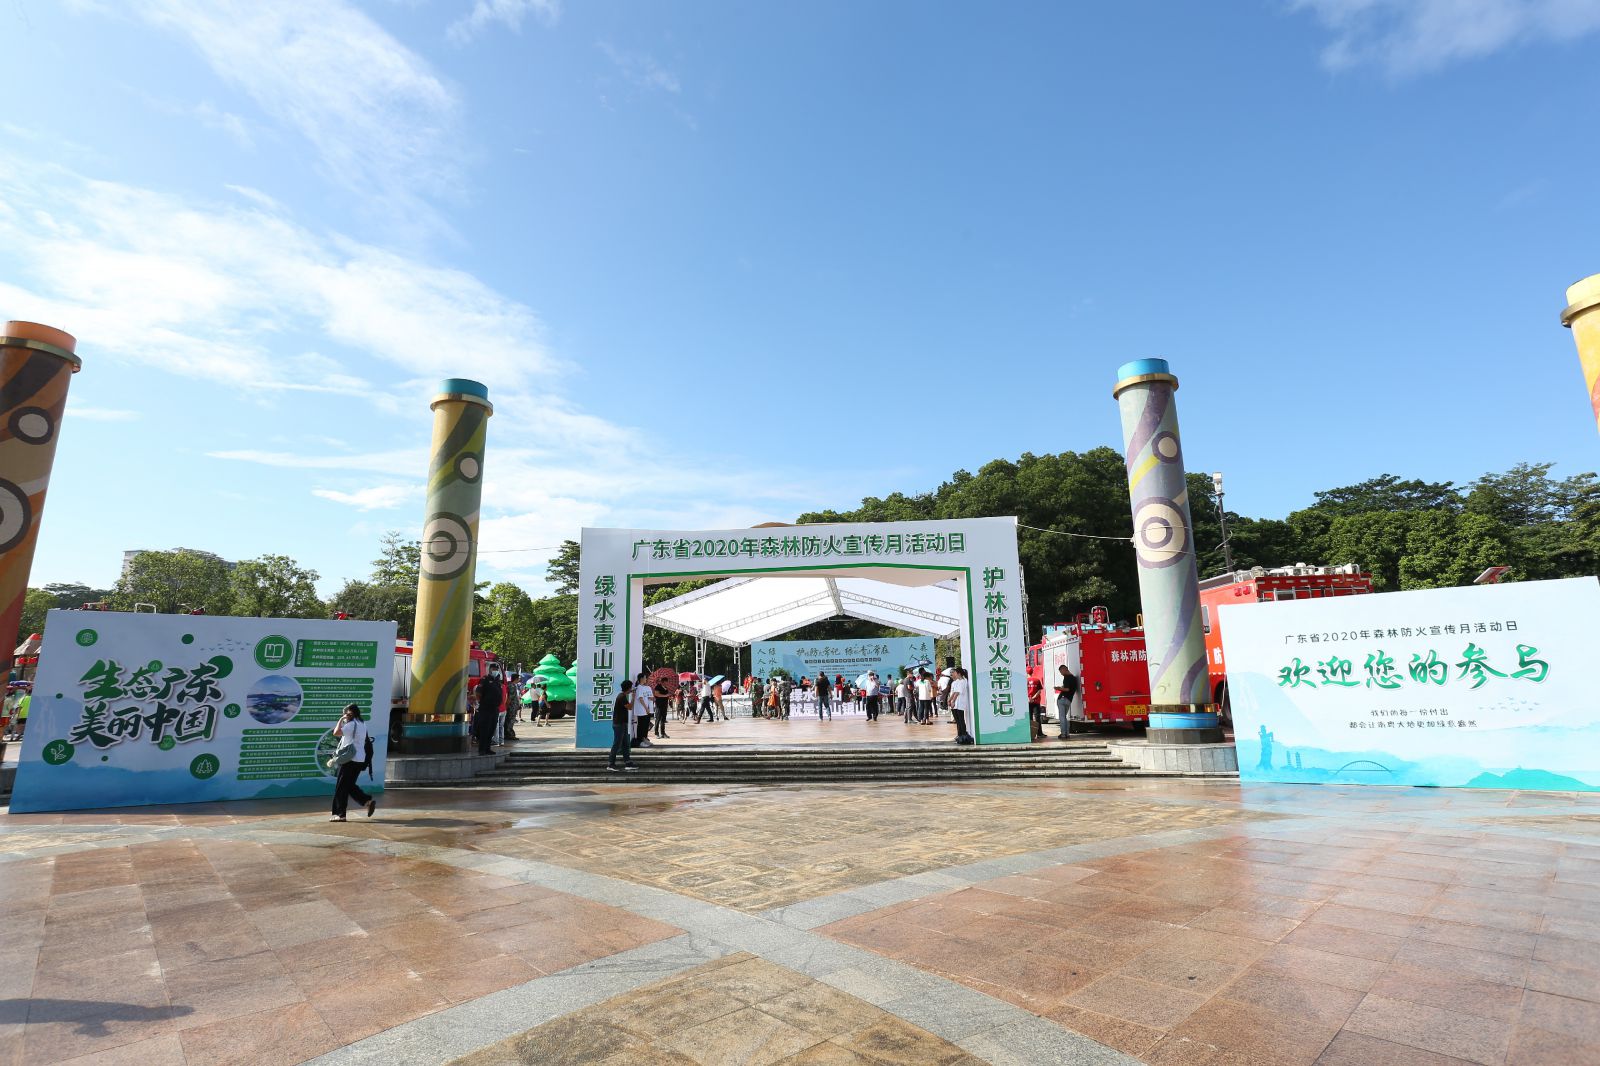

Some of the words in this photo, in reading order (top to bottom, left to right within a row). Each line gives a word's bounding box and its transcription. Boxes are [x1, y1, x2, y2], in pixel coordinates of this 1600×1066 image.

[632, 532, 966, 560] 广东省2020年森林防火宣传月活动日
[590, 575, 617, 722] 绿水青山常在
[983, 567, 1013, 716] 护林防火常记
[1285, 620, 1518, 645] 广东省2020年森林防火宣传月活动日
[79, 659, 223, 703] 生态广东
[1277, 643, 1551, 690] 欢迎您的参与
[790, 688, 842, 702] 绿水山
[69, 700, 216, 748] 美丽中国
